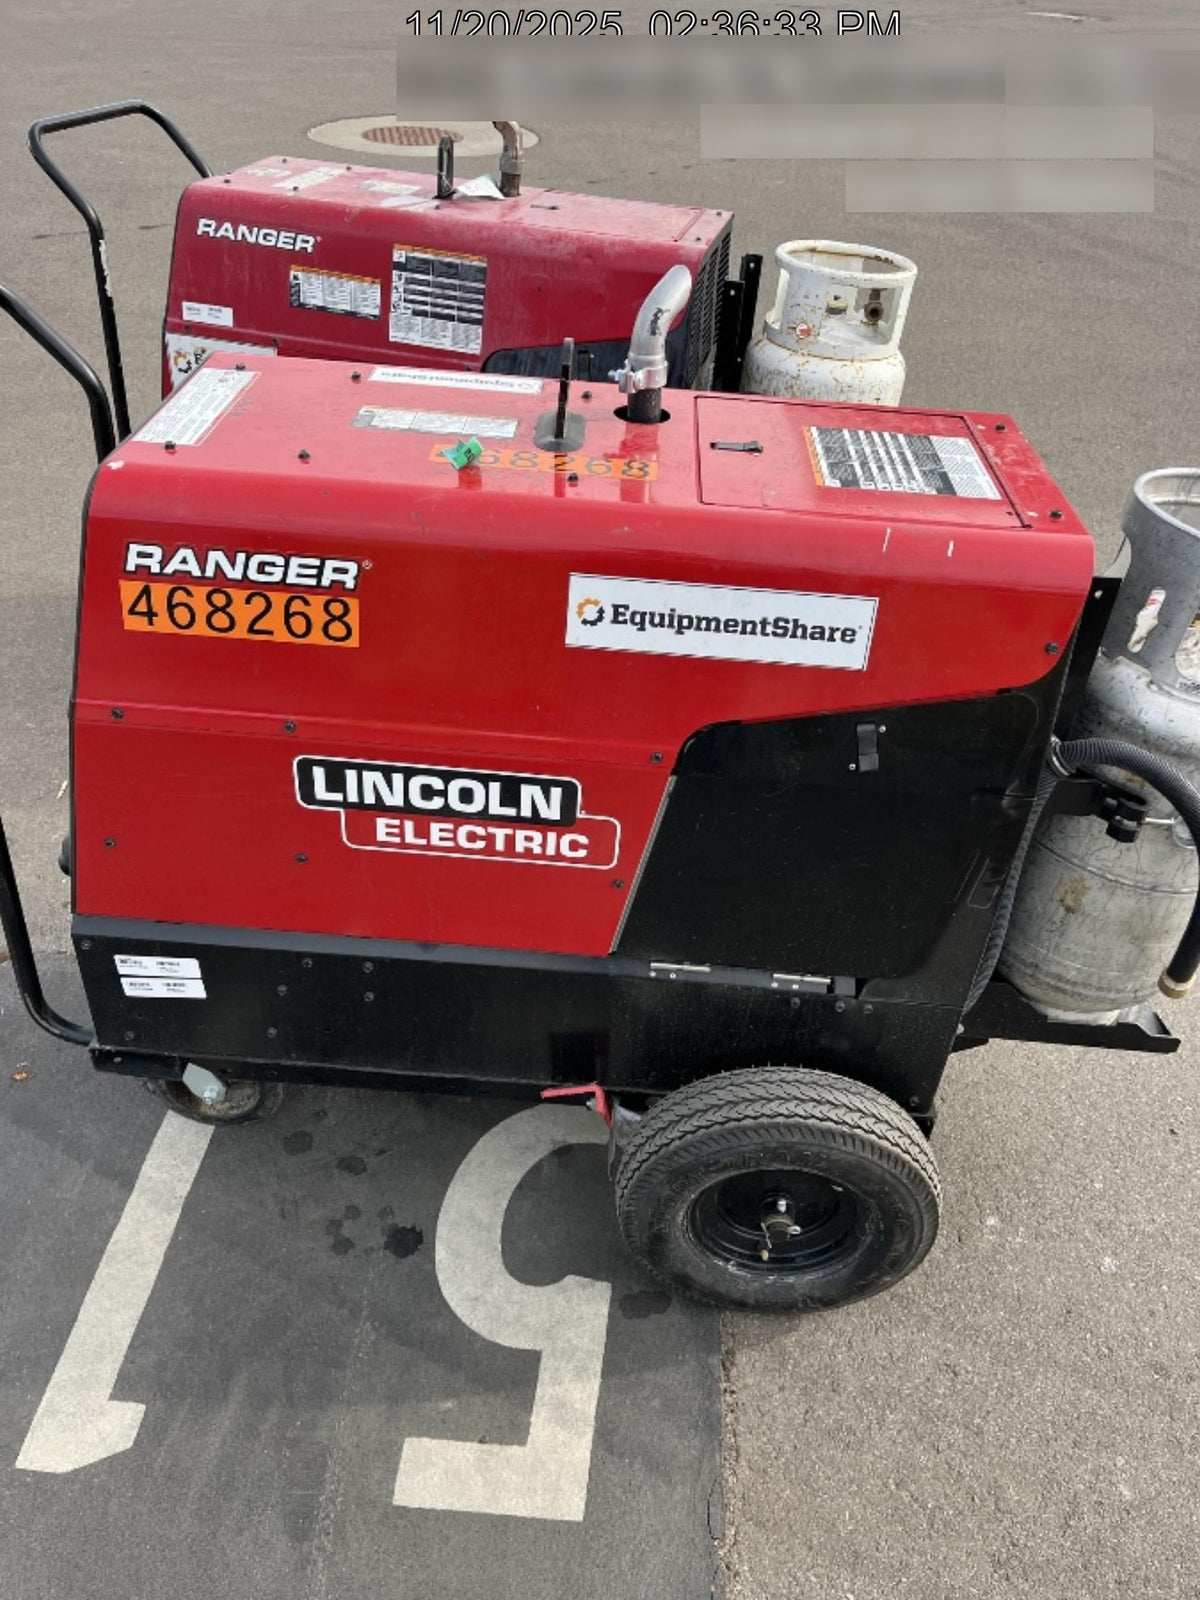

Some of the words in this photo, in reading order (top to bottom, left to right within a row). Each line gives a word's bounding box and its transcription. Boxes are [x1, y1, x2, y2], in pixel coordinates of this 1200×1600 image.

[196, 217, 316, 253] RANGER
[124, 542, 359, 590] RANGER
[127, 584, 353, 642] 468268
[609, 603, 857, 644] EquipmentShare
[311, 765, 563, 821] LINCOLN
[375, 816, 590, 858] ELECTRIC
